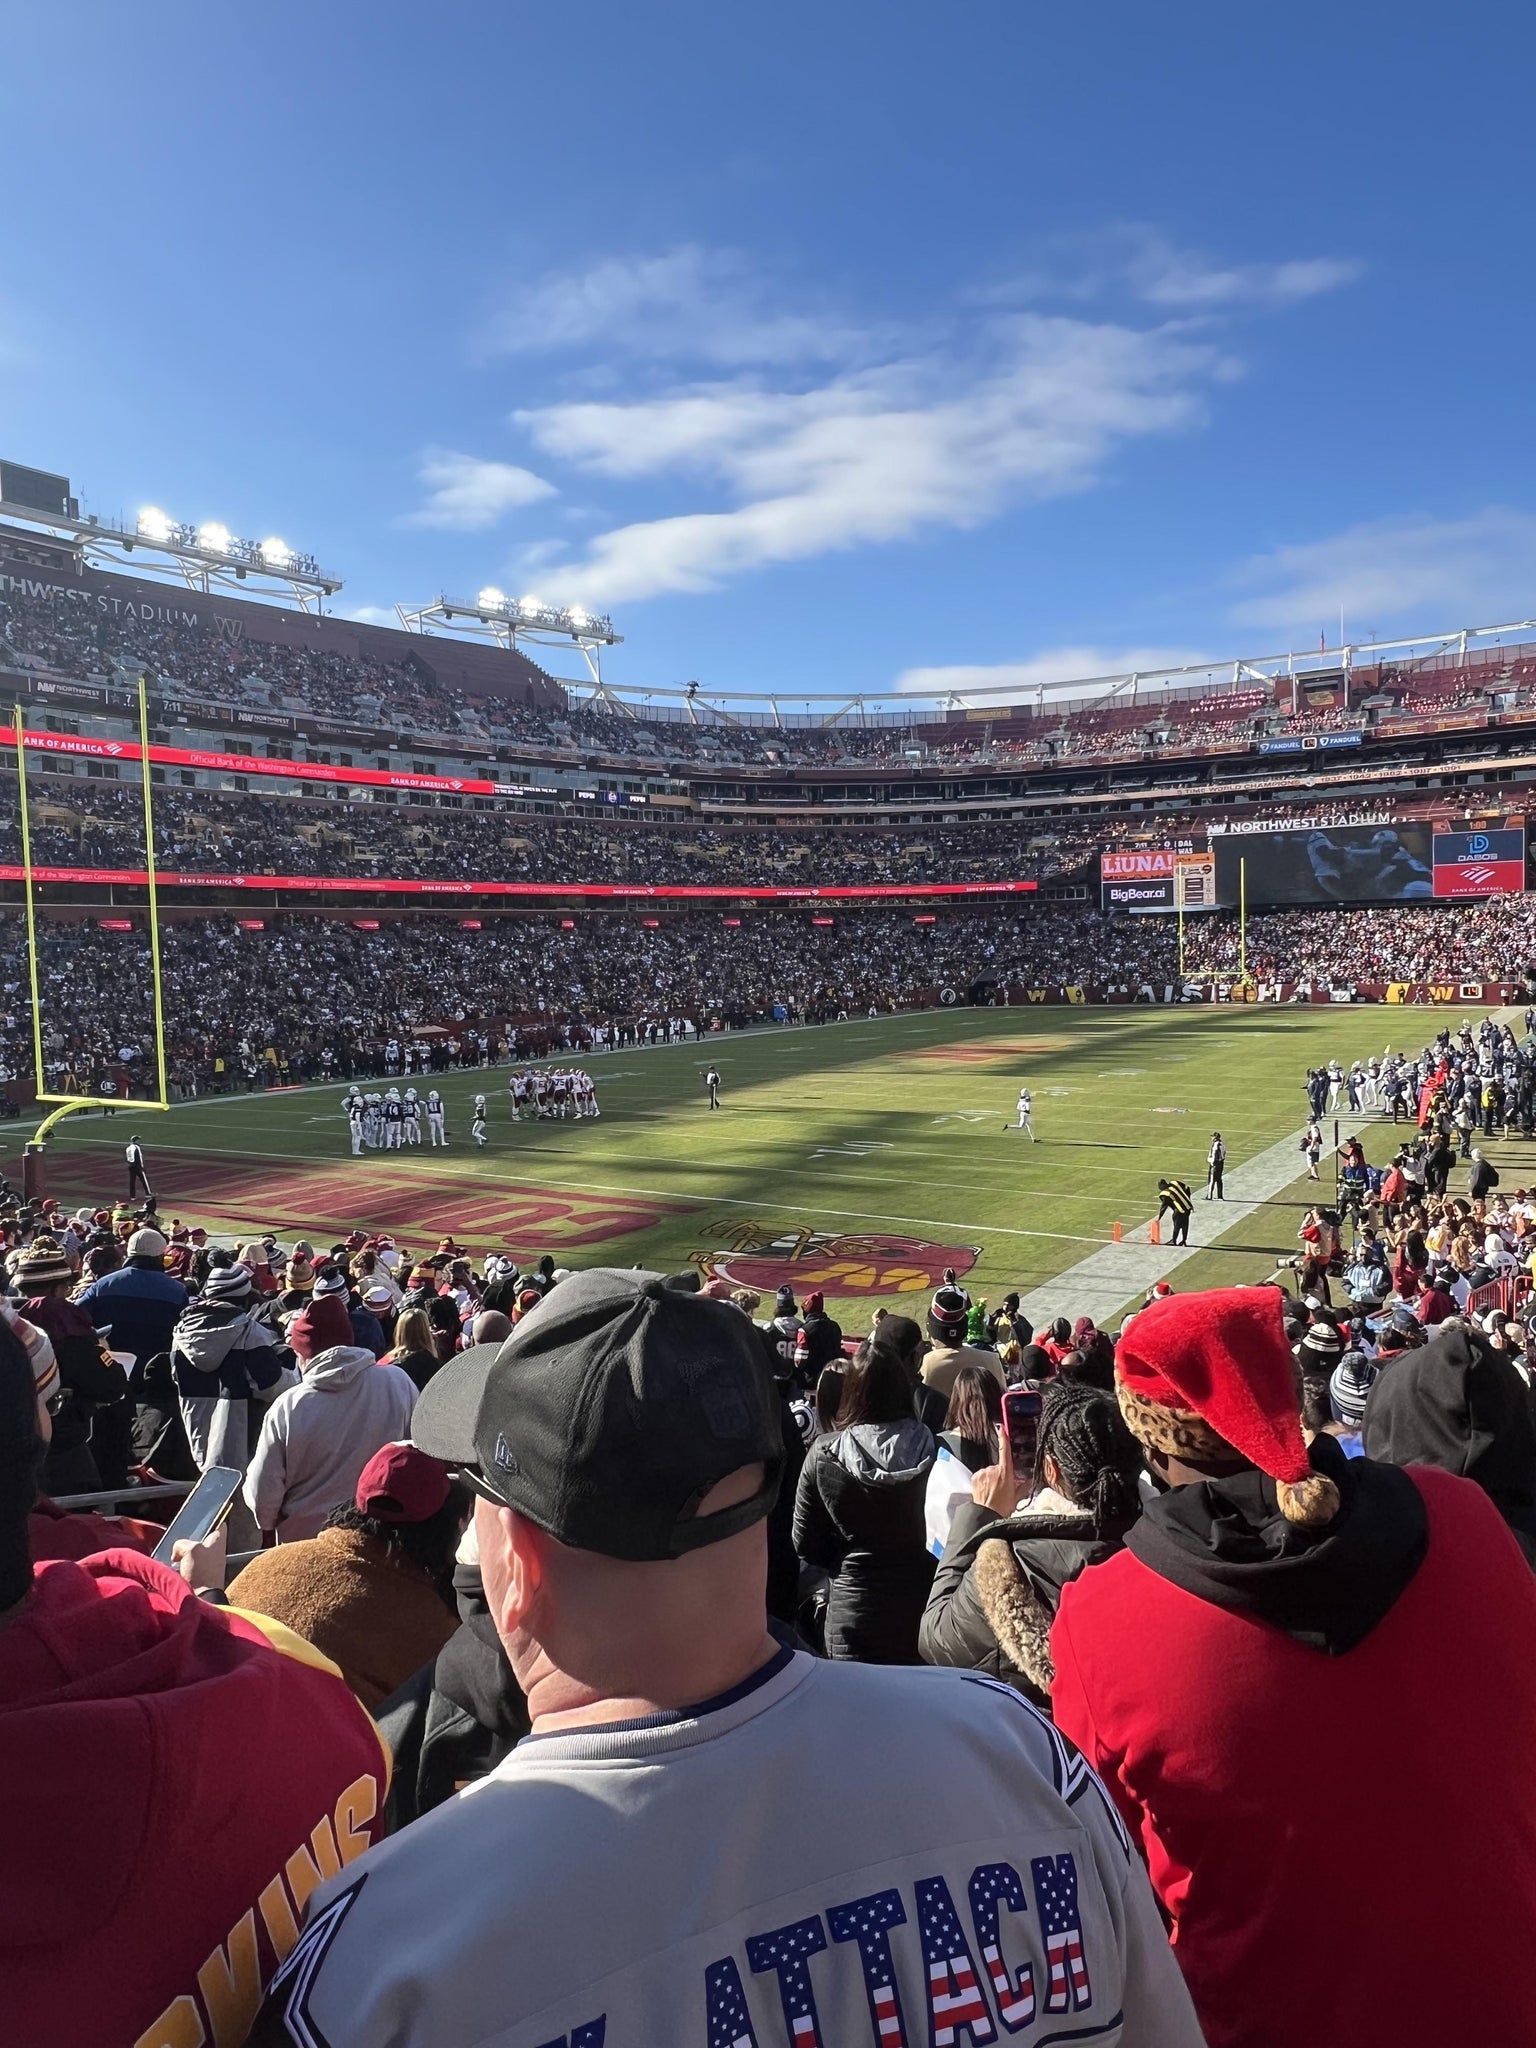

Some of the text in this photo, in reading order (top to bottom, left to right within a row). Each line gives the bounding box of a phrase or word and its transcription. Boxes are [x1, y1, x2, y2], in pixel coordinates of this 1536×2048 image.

[97, 595, 197, 628] STADIUM
[24, 736, 103, 753] ANK OF AMERICA
[1270, 742, 1300, 750] FANDUEL
[1329, 736, 1361, 744] FANDUEL
[420, 780, 449, 790] AMERICA
[1208, 784, 1241, 793] WORLD
[1243, 779, 1301, 790] CHAMPIONS
[1230, 817, 1318, 833] NORTHWEST
[1320, 812, 1390, 827] STADIUM
[1110, 887, 1166, 901] BigBear.ai
[1467, 987, 1478, 996] 14
[704, 1852, 1092, 2048] ATTACK
